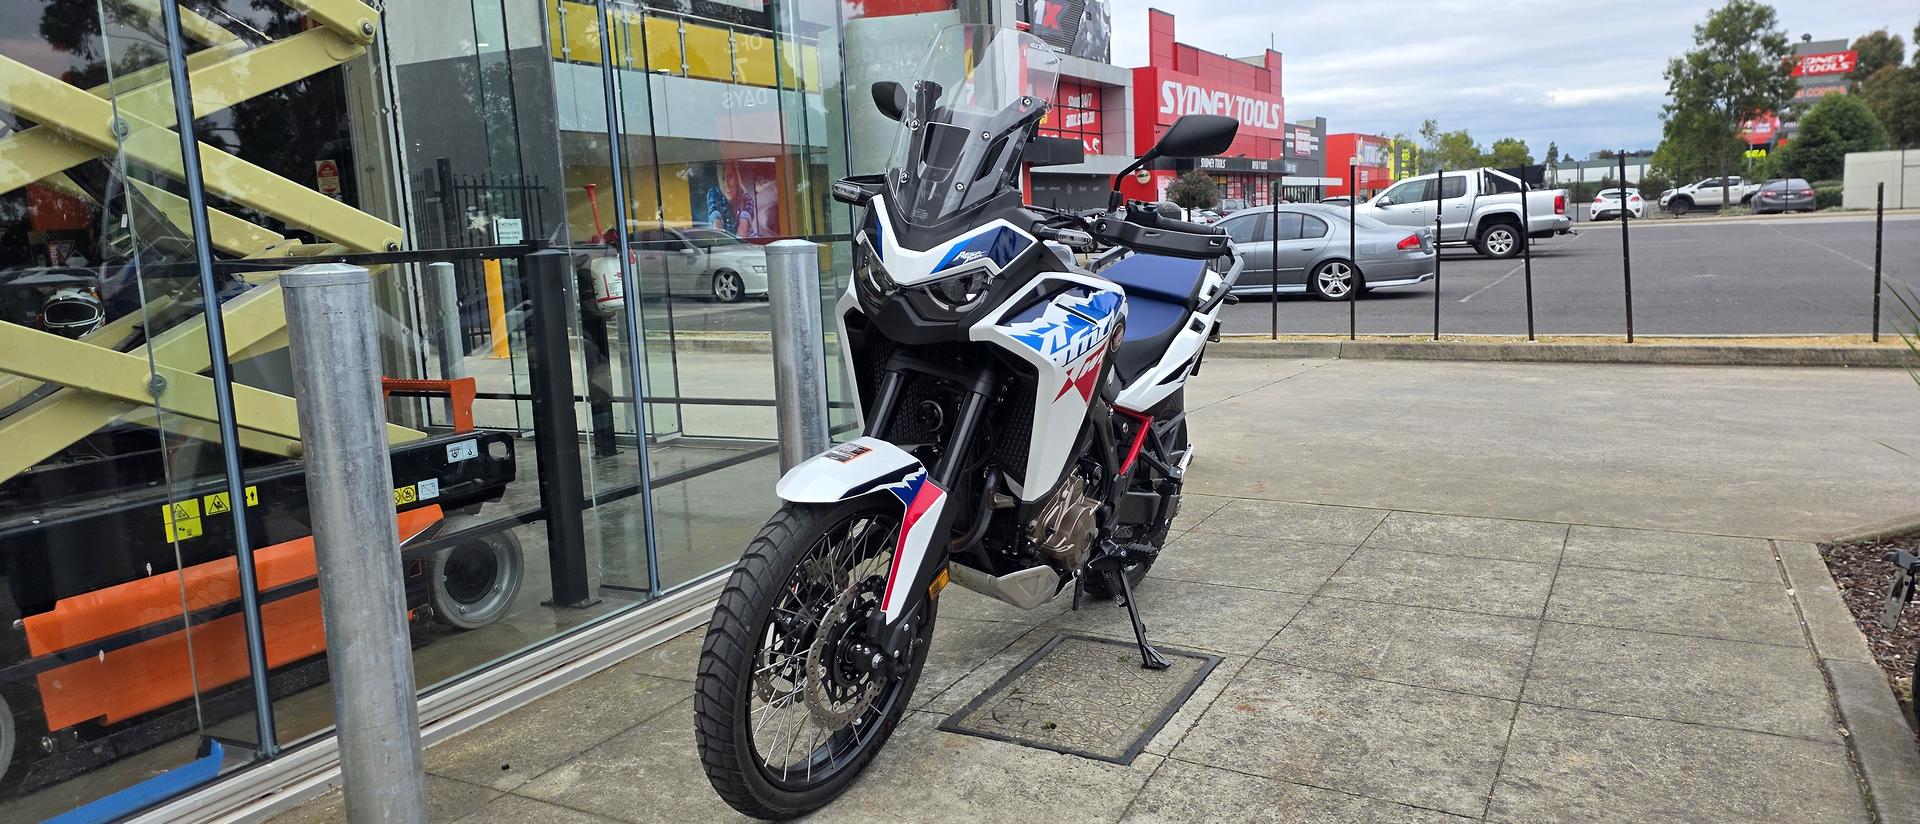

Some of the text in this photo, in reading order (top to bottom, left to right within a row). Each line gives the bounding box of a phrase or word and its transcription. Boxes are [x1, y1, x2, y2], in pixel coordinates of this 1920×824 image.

[1159, 79, 1281, 130] SYDNEY TOOLS
[1215, 158, 1226, 169] TOOLS
